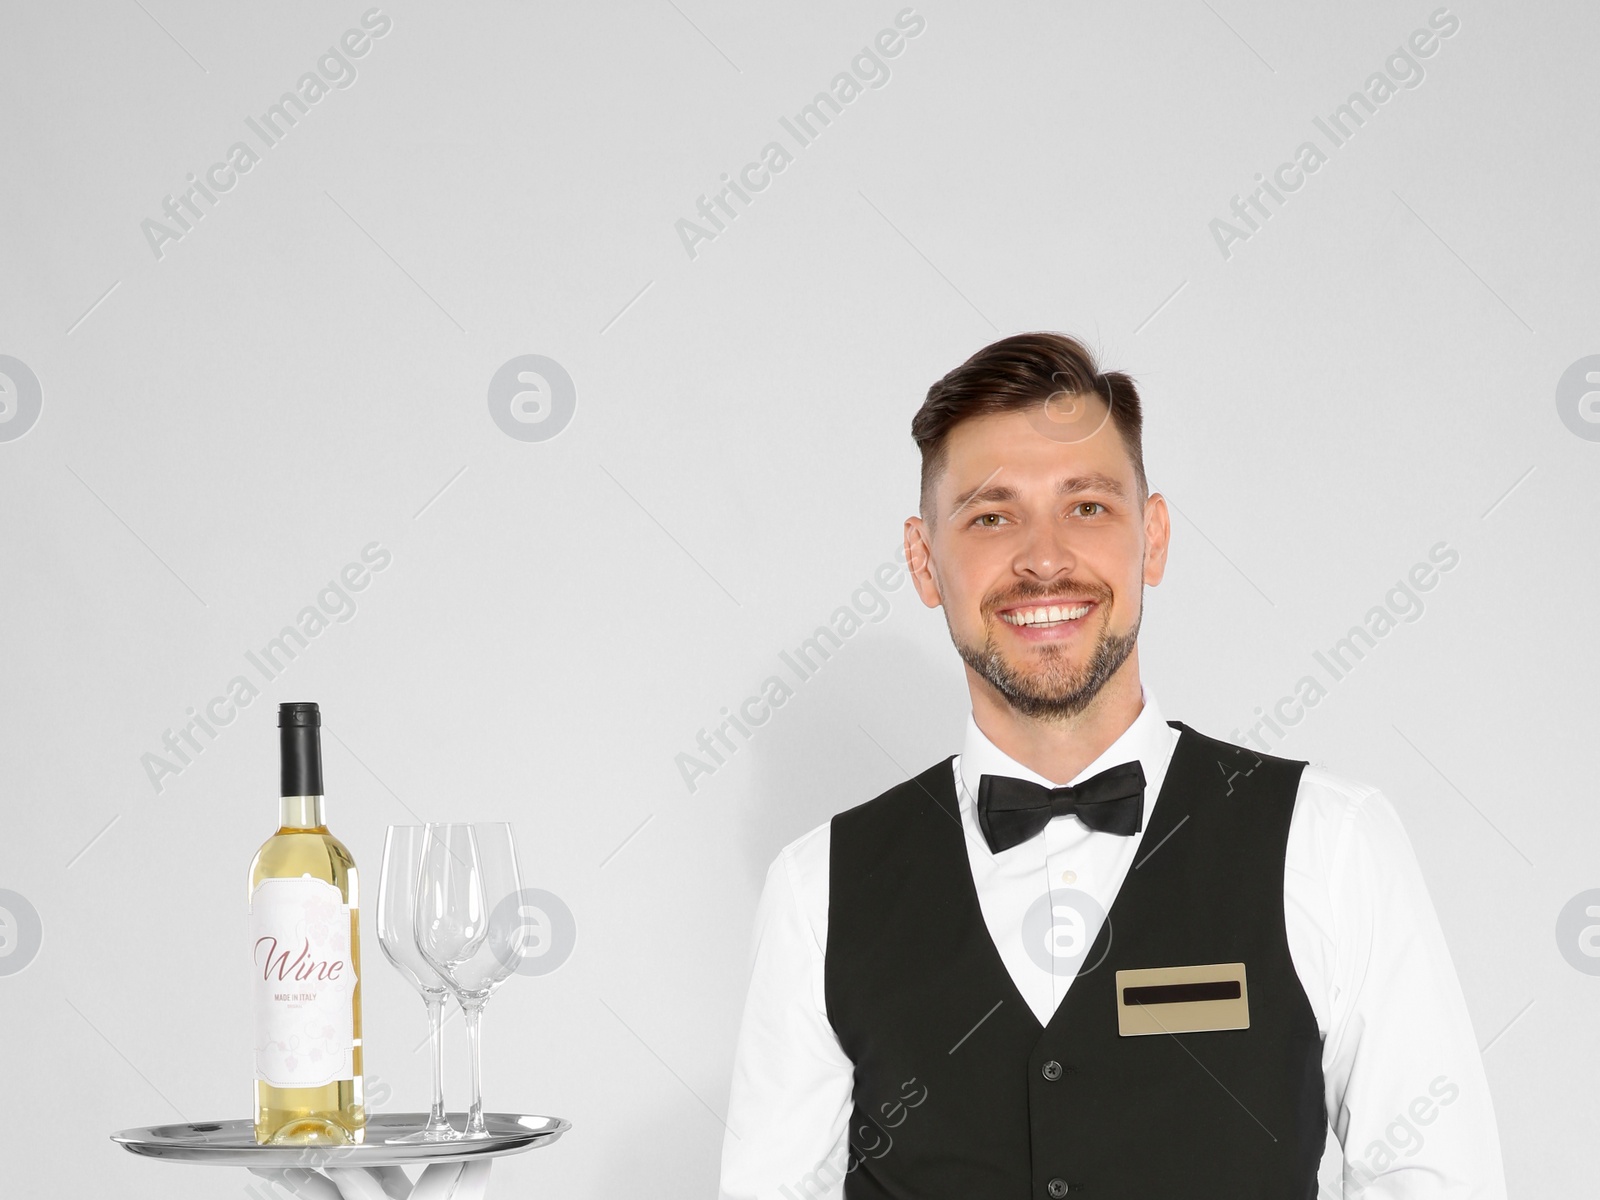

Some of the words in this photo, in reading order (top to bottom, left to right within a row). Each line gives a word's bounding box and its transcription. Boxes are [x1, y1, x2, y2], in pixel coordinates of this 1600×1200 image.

[254, 936, 344, 981] Wine
[274, 993, 290, 1001] MADE
[291, 993, 299, 1001] IN
[299, 993, 317, 1001] ITALY
